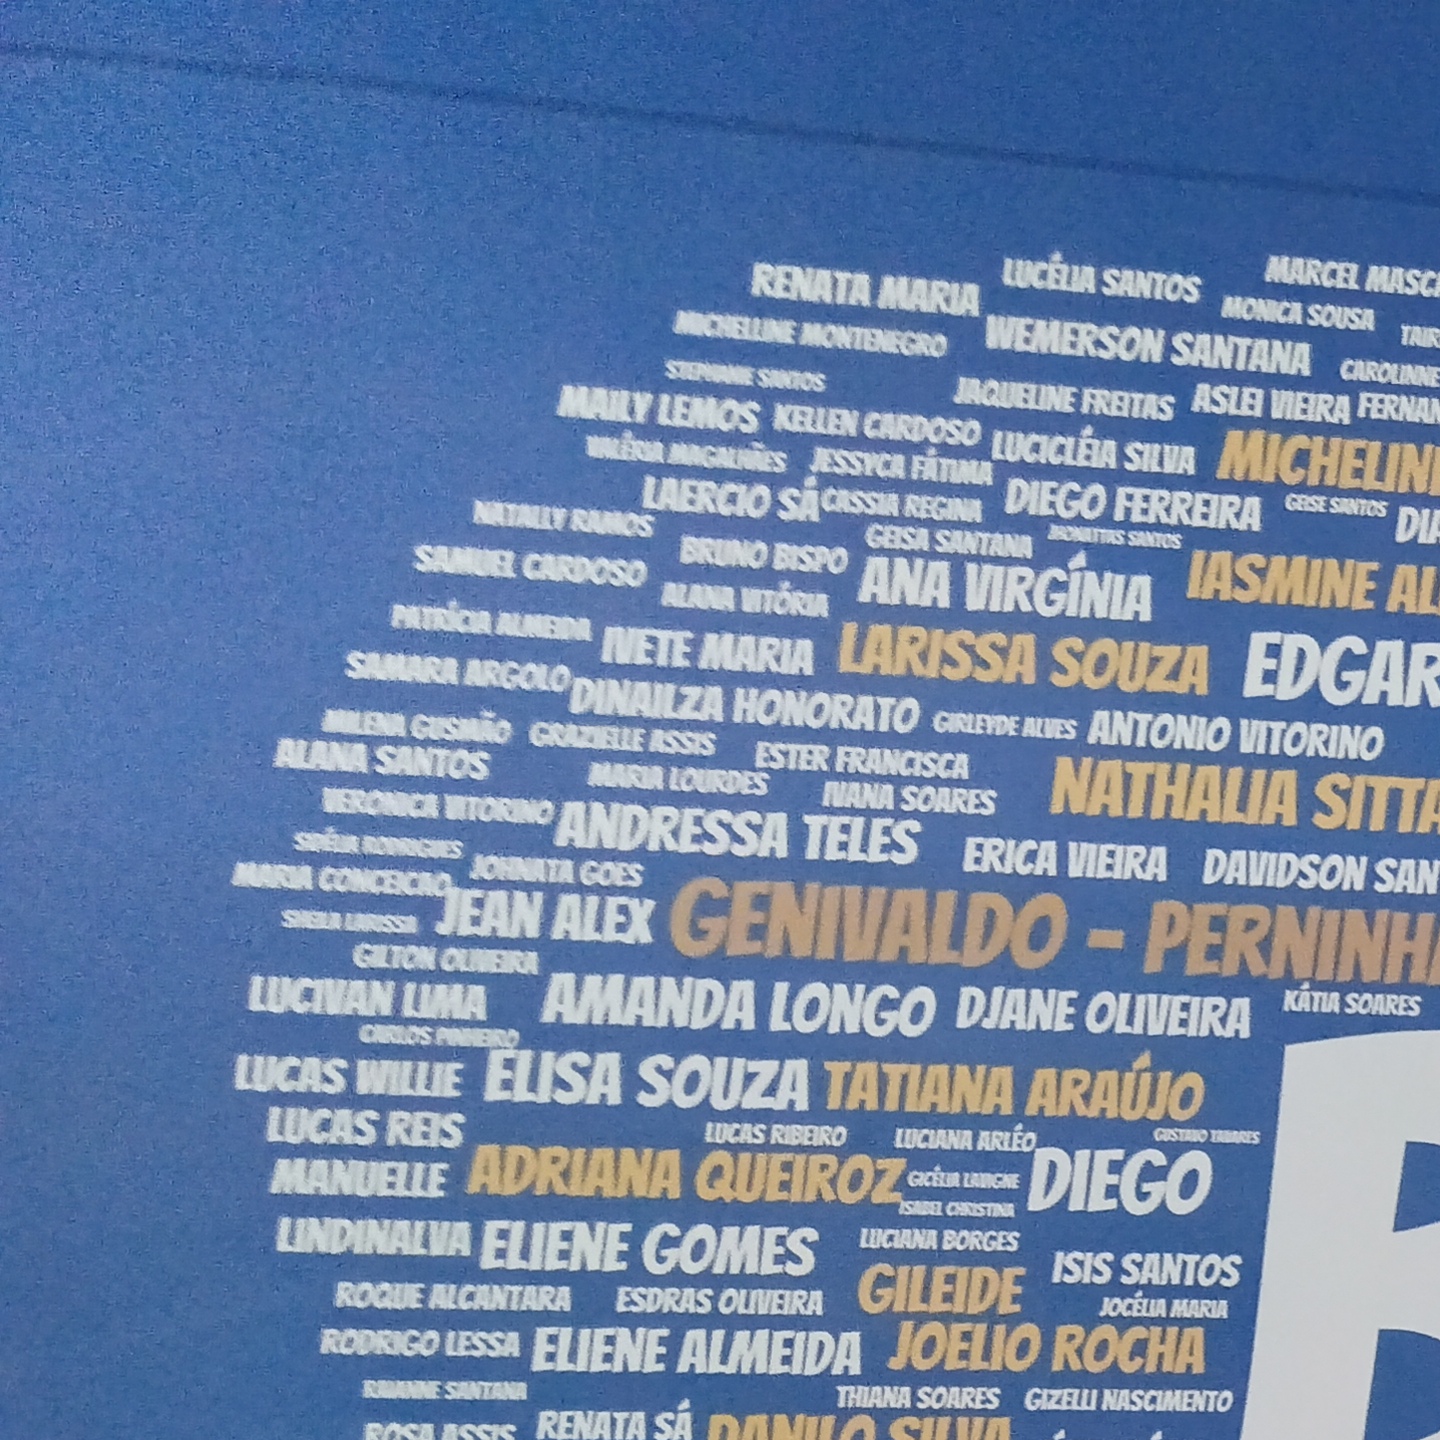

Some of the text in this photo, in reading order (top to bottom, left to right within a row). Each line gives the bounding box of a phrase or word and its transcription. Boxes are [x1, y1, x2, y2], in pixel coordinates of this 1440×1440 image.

[752, 263, 979, 316] RENATA MARIA
[1265, 256, 1359, 289] MARCEL
[1187, 550, 1379, 610] IASMINE
[839, 622, 1208, 695] LARISSA SOUZA
[1050, 757, 1297, 826] NATHALIA
[670, 877, 1067, 969] GENIVALDO
[541, 973, 936, 1037] AMANDA LONGO
[235, 1055, 463, 1097] LUCAS WILLIE
[824, 1051, 1204, 1121] TATIANA ARAÚJO
[467, 1144, 906, 1204] ADRIANA QUEIROZ
[858, 1263, 1025, 1314] GILEIDE
[888, 1321, 1204, 1373] JOELIO ROCHA
